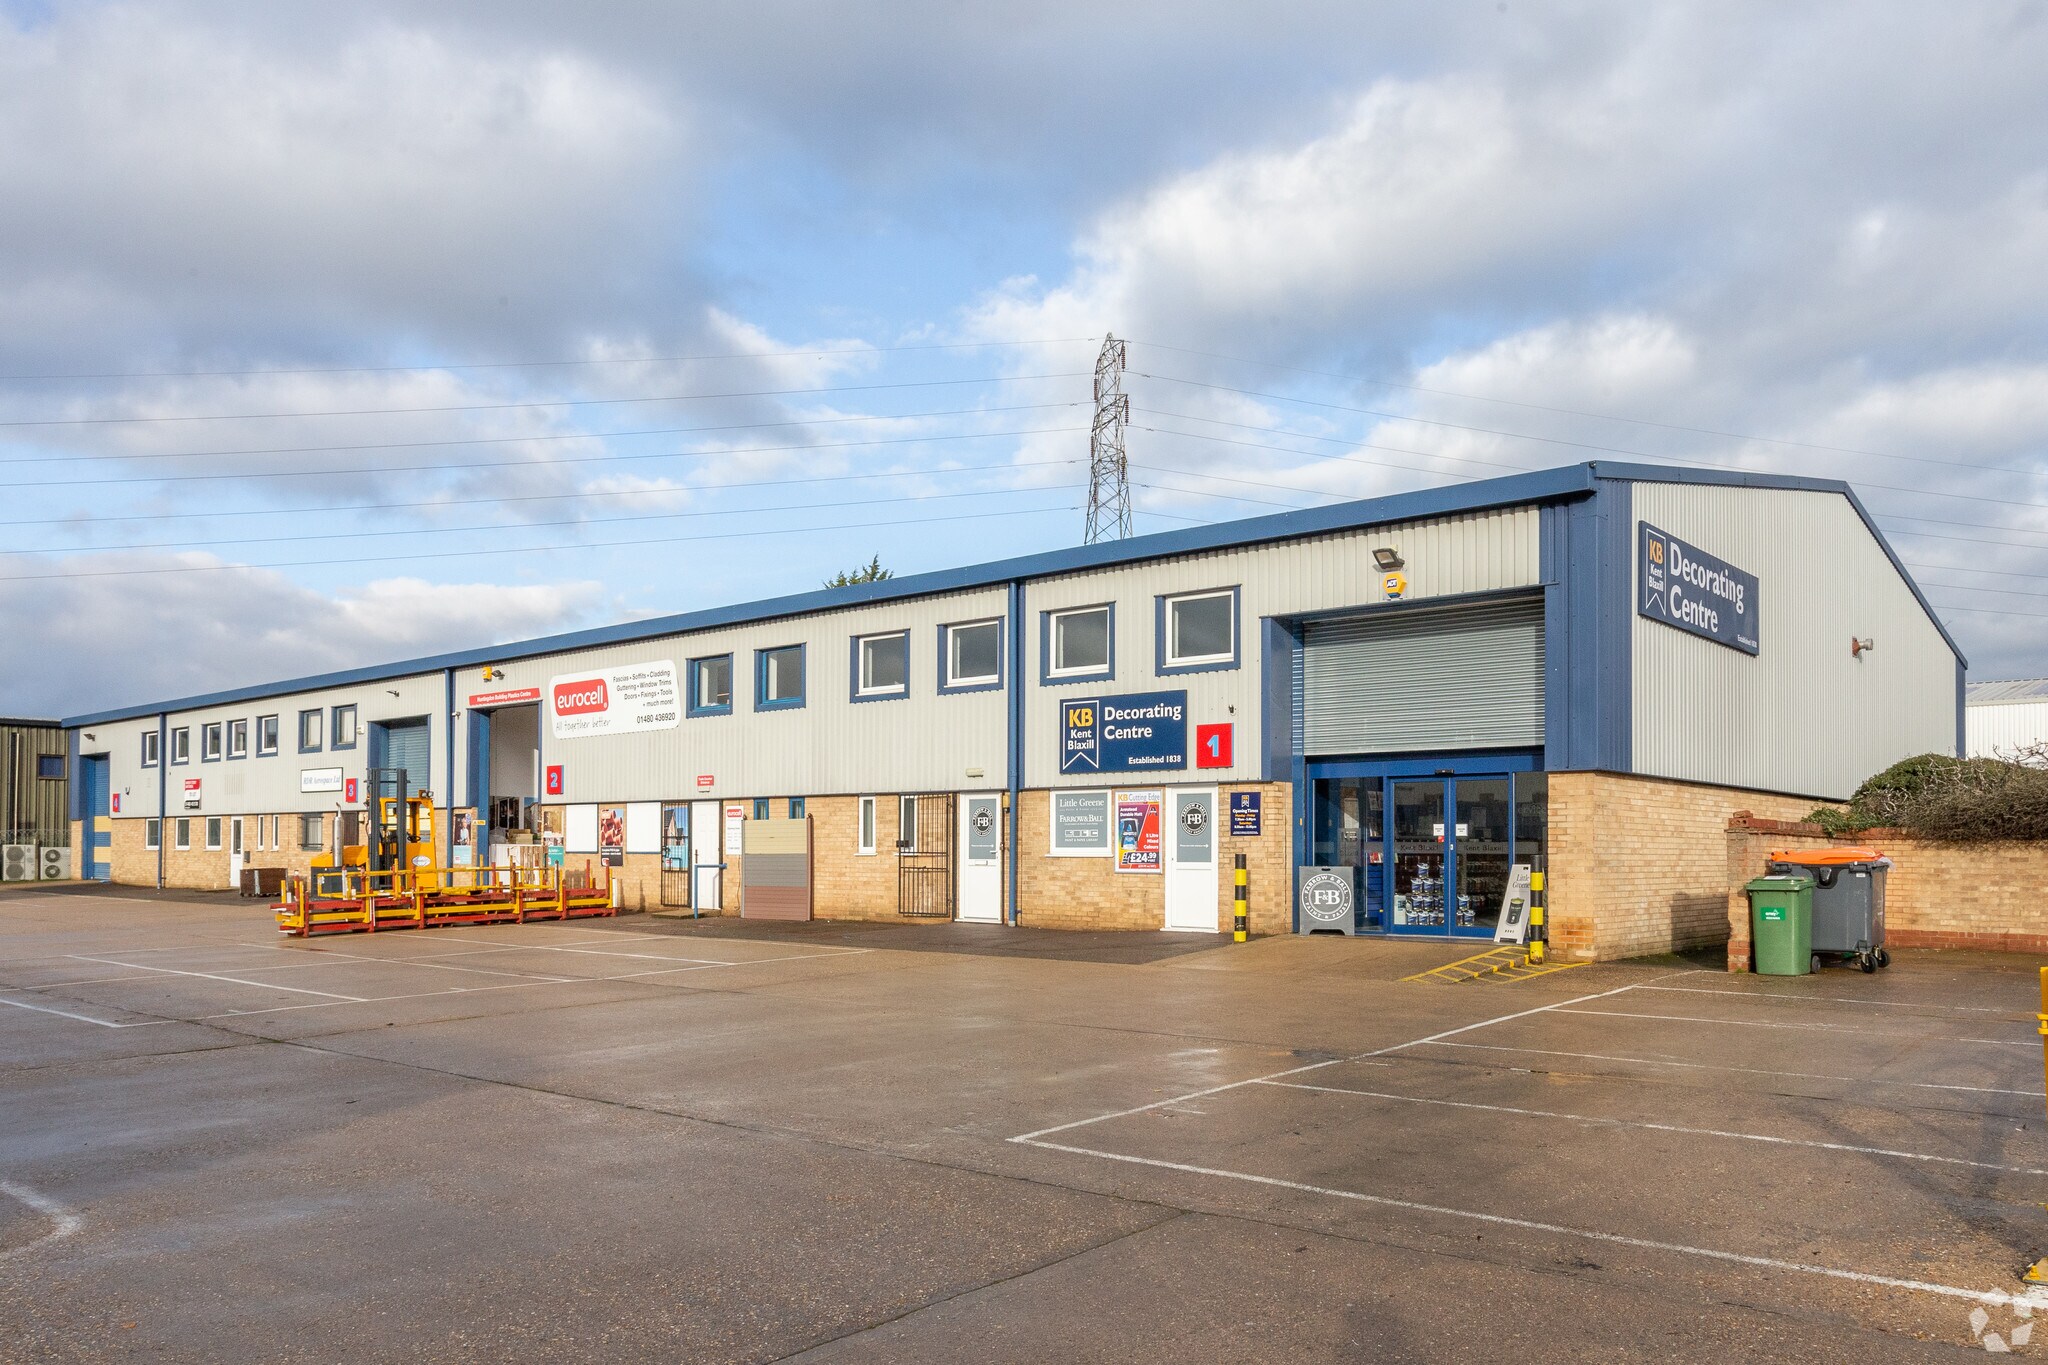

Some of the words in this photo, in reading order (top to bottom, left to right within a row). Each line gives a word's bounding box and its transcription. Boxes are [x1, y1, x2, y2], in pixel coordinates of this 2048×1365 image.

[1650, 539, 1663, 564] KB
[1650, 564, 1662, 578] Kent
[1670, 542, 1744, 614] Decorating
[1649, 576, 1664, 592] Blaxill
[1670, 585, 1718, 632] Centre
[650, 670, 670, 678] Cladding
[558, 685, 603, 709] eurocell
[637, 715, 654, 724] 01480
[654, 712, 676, 723] 436920
[1069, 708, 1093, 727] KB
[1104, 703, 1181, 720] Decorating
[565, 718, 590, 732] together
[592, 717, 611, 728] better
[1071, 729, 1092, 739] Kent
[1104, 726, 1152, 739] Centre
[1068, 739, 1094, 750] Blaxill
[1207, 734, 1219, 757] 1
[1128, 756, 1164, 764] Established
[550, 772, 558, 788] 2
[349, 784, 354, 797] 3
[1148, 793, 1160, 801] Edge
[1060, 798, 1078, 807] Little
[1079, 798, 1104, 807] Greene
[1305, 875, 1328, 894] FARROW
[1336, 879, 1348, 894] BALL
[1314, 890, 1340, 905] F&B
[1306, 902, 1321, 917] PAINT
[1333, 902, 1348, 917] PAPER
